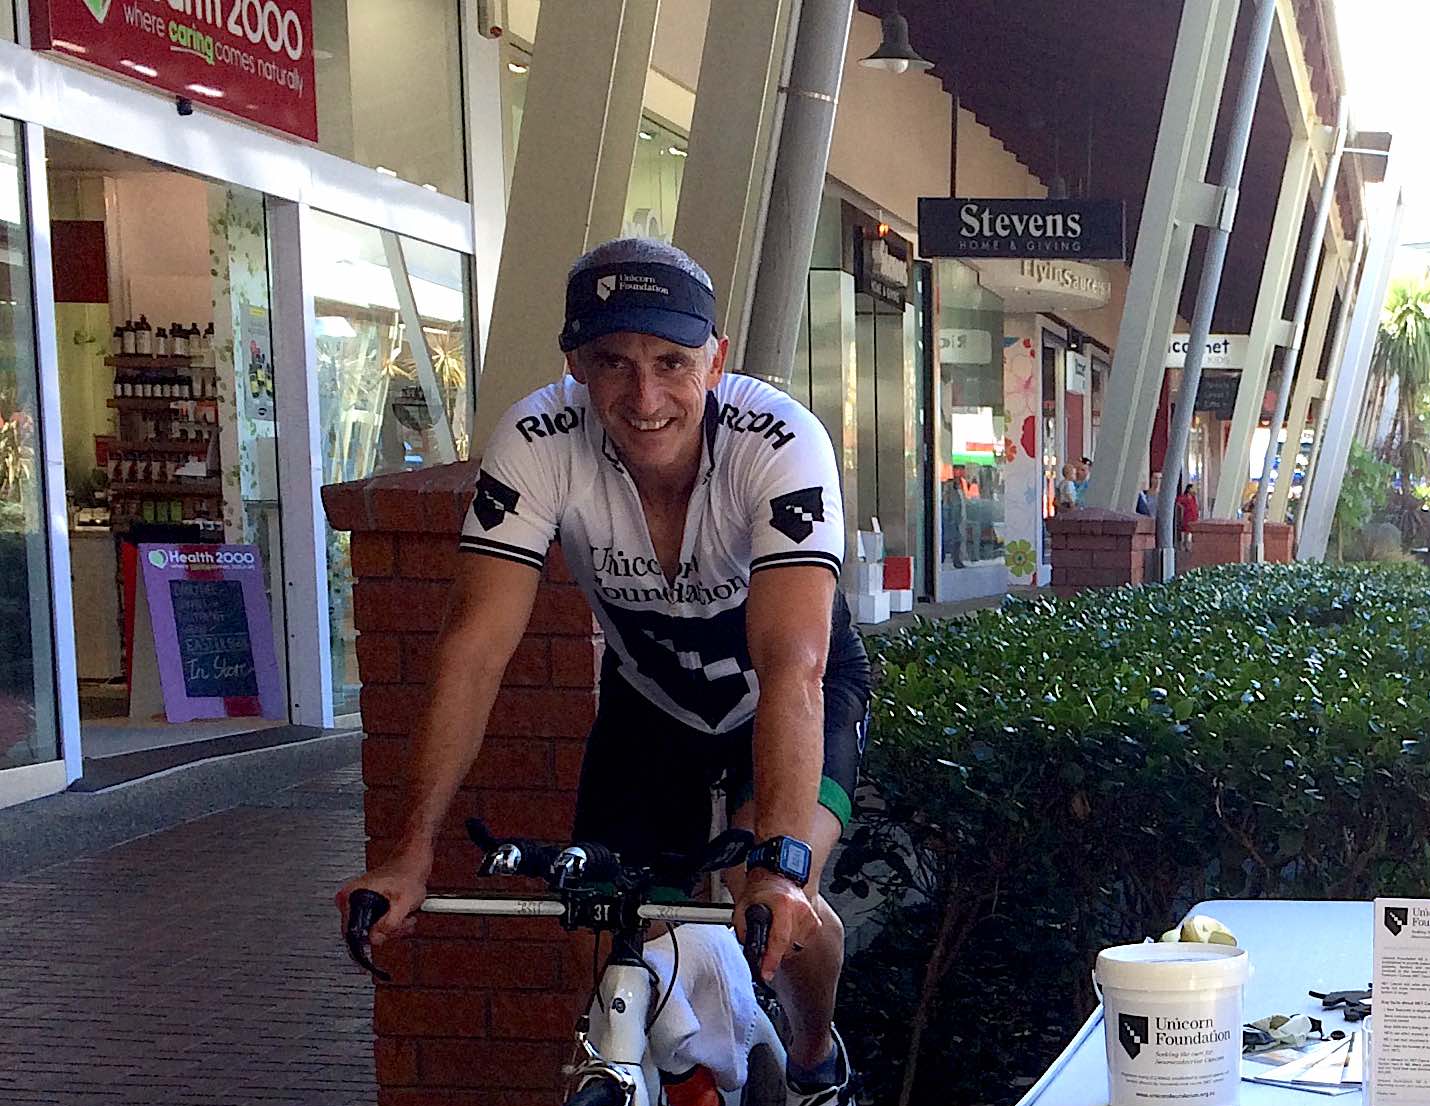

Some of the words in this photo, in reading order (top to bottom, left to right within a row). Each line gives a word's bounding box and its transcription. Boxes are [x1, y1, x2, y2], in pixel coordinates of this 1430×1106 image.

[227, 0, 303, 61] 2000
[123, 3, 165, 38] where
[168, 19, 215, 65] caring
[214, 42, 256, 74] comes
[257, 58, 304, 98] naturally
[960, 204, 1081, 238] Stevens
[959, 240, 999, 251] HOME
[1026, 240, 1081, 251] GIVING
[619, 282, 670, 295] Foundation
[168, 550, 214, 564] Health
[216, 551, 255, 564] 2000
[593, 904, 610, 921] 3T
[1155, 1017, 1214, 1031] Unicorn
[1155, 1030, 1231, 1046] Foundation
